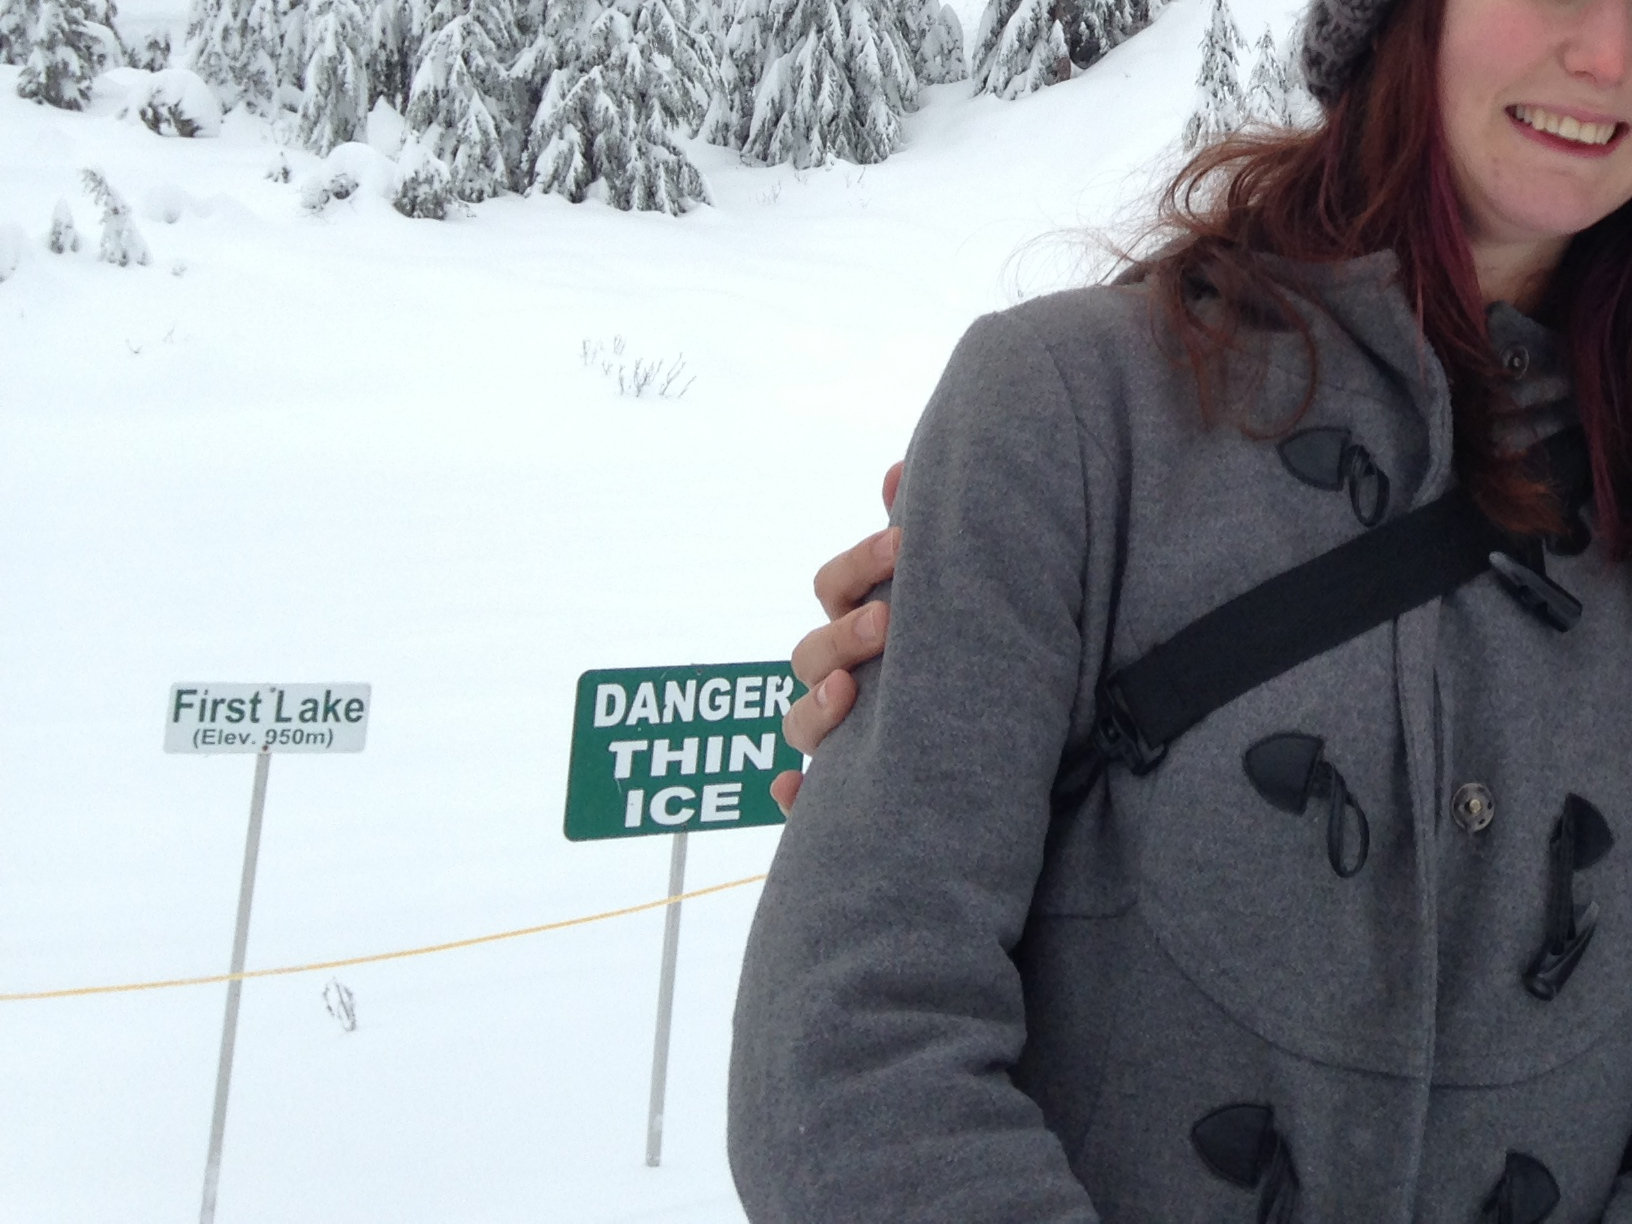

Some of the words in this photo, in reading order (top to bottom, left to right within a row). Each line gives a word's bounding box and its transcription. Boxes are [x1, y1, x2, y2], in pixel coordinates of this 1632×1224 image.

[173, 689, 262, 723] First
[275, 689, 364, 723] Lake
[594, 675, 794, 727] DANGER
[193, 728, 256, 748] (Elev.
[264, 728, 334, 748] 950m)
[608, 733, 776, 779] THIN
[625, 783, 742, 828] ICE
